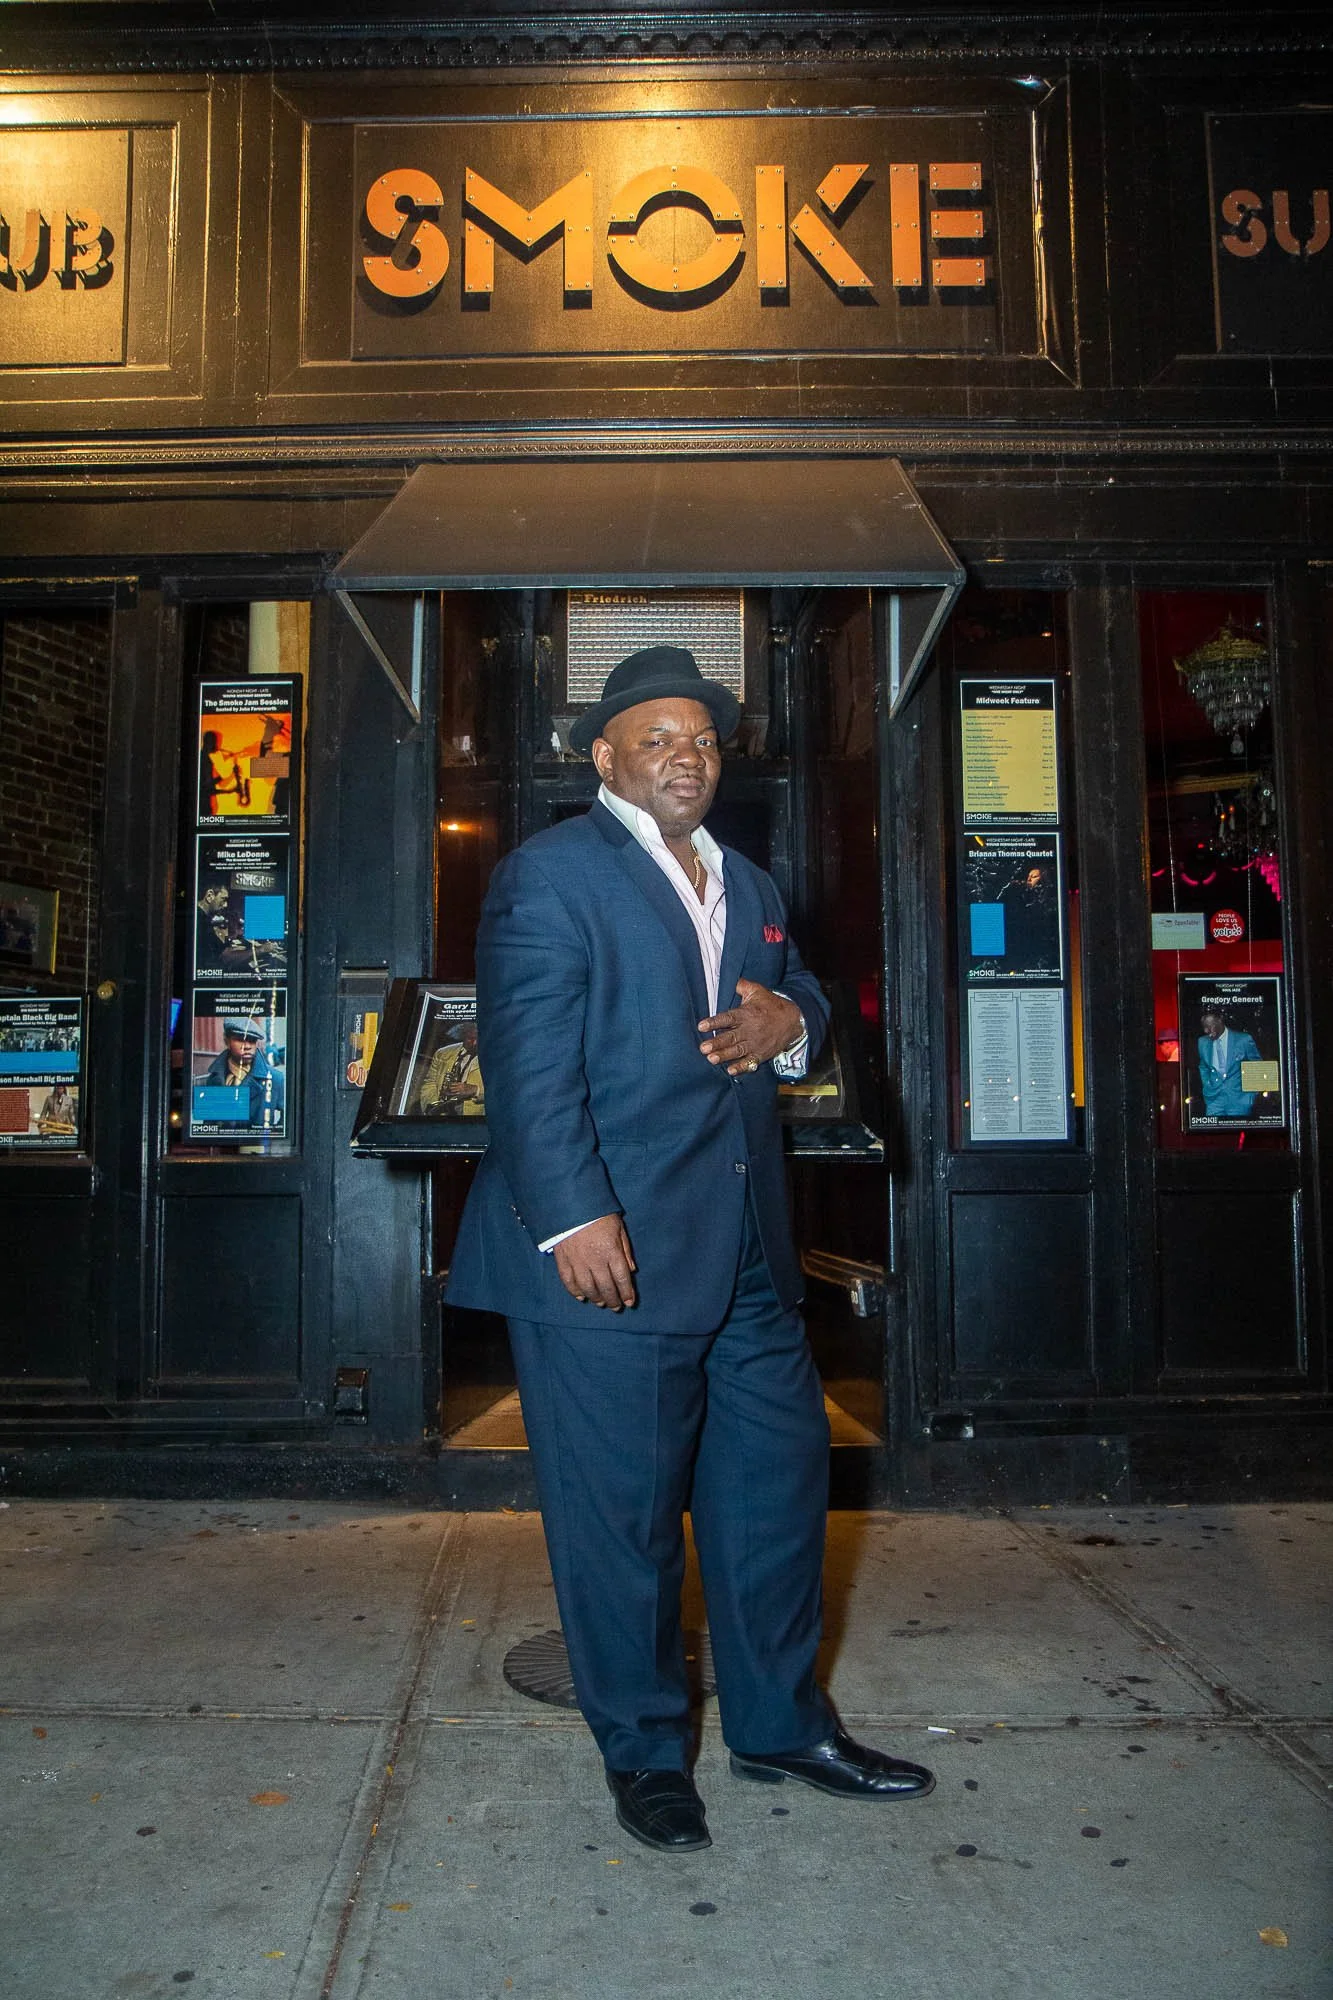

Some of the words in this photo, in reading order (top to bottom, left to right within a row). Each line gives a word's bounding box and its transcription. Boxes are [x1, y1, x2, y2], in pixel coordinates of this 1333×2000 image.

[362, 161, 986, 300] SMOKE
[584, 593, 648, 604] Friedrich
[260, 698, 289, 706] Session
[968, 850, 997, 858] Brianna
[1026, 850, 1054, 858] Quartet
[1214, 926, 1234, 938] yelp
[969, 969, 995, 977] SMOKE
[1202, 996, 1231, 1004] Gregory
[1232, 995, 1264, 1003] Generet
[44, 1014, 58, 1022] Big
[44, 1076, 56, 1084] Big
[57, 1075, 75, 1083] Band
